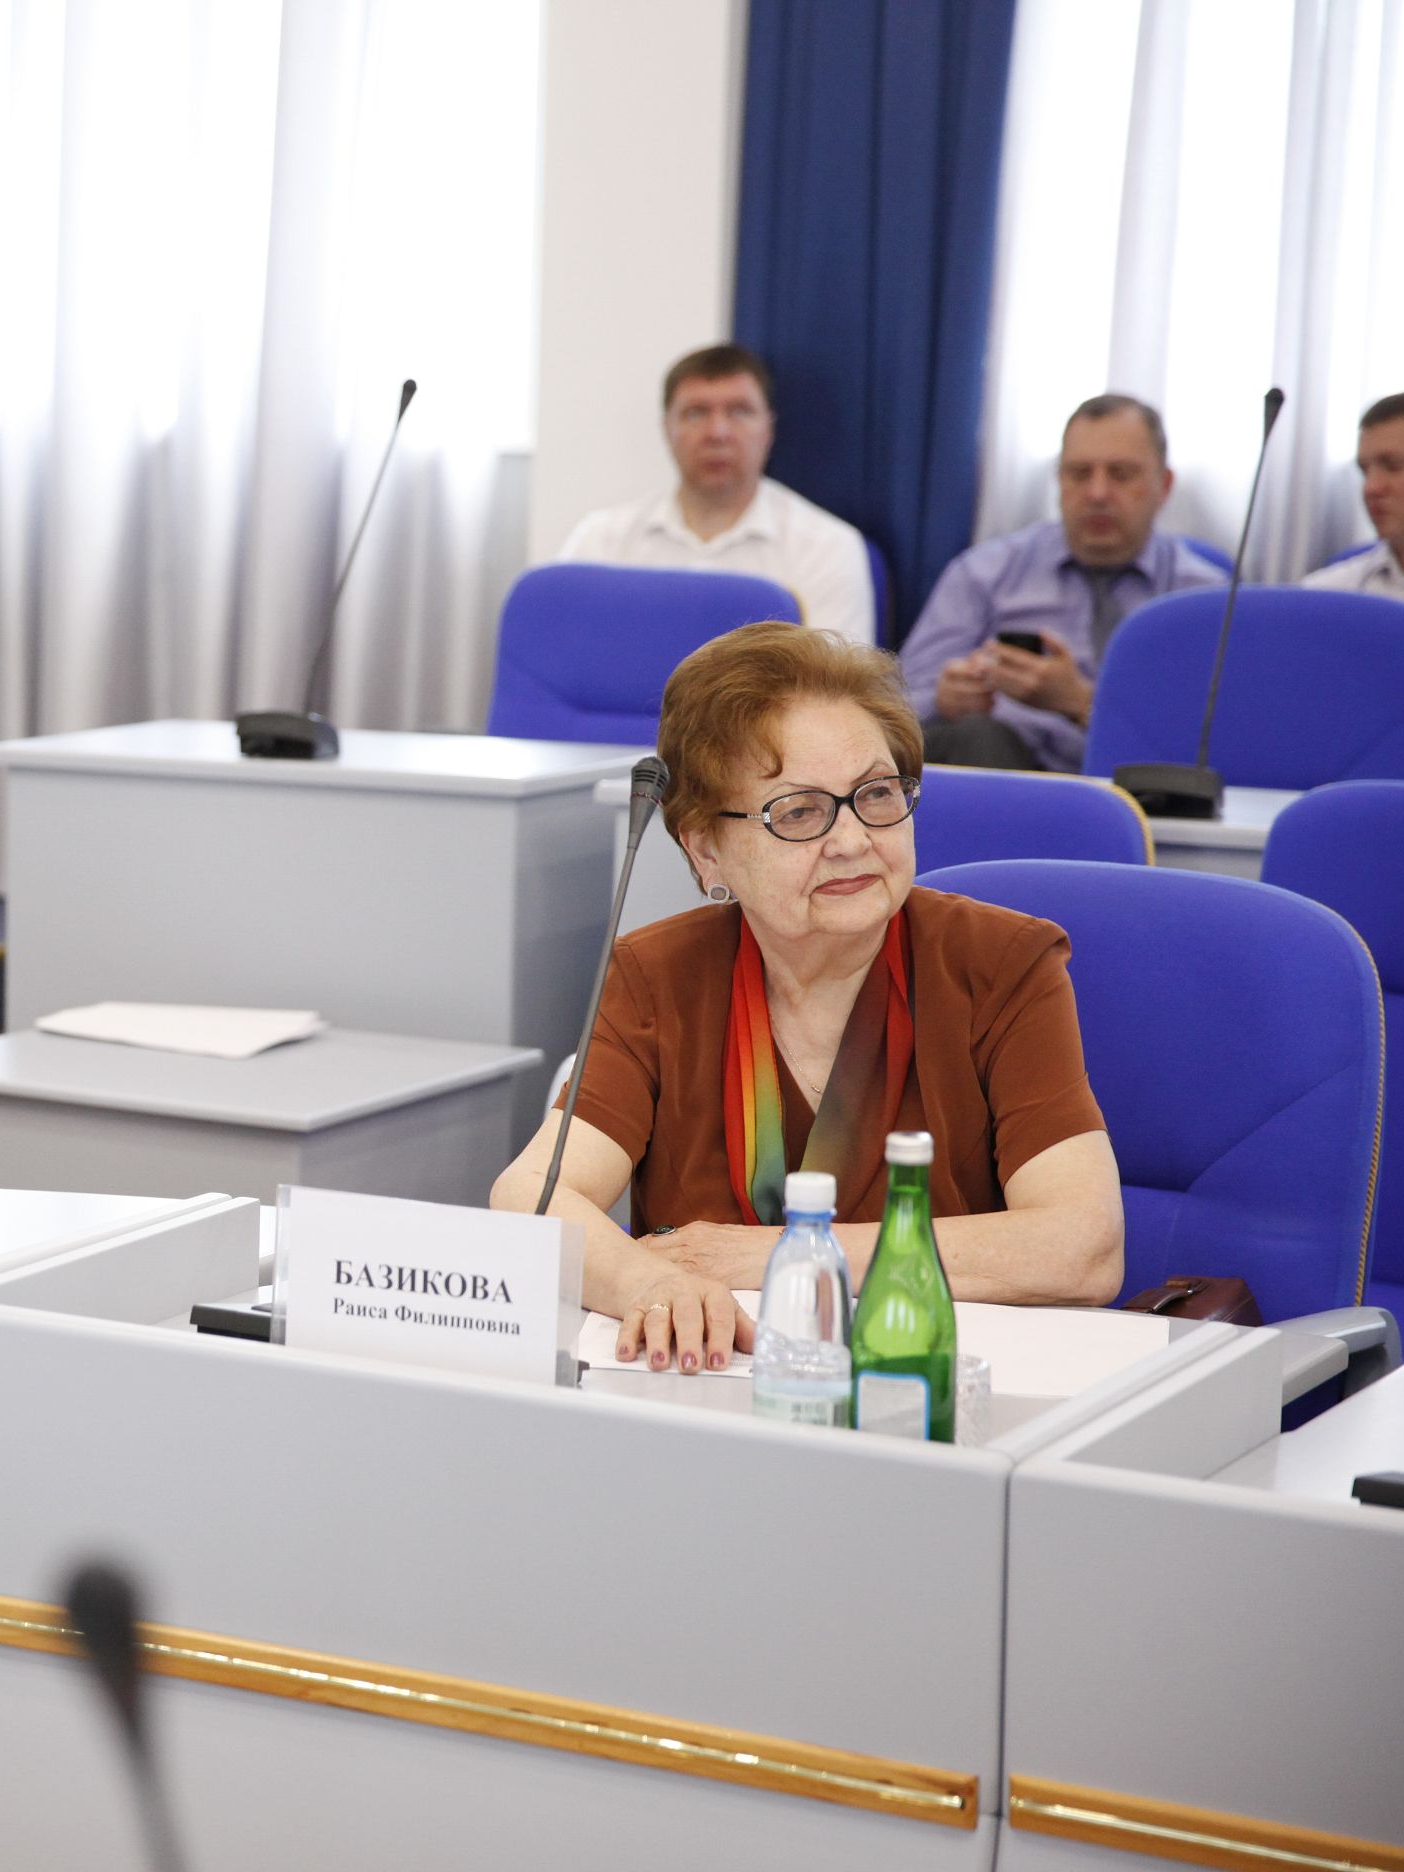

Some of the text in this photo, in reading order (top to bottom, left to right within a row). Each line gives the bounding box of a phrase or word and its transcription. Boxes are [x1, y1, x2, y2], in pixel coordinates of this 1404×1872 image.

[334, 1259, 513, 1304] БАЗИКОВА
[333, 1297, 521, 1335] Раиса Филипповна
